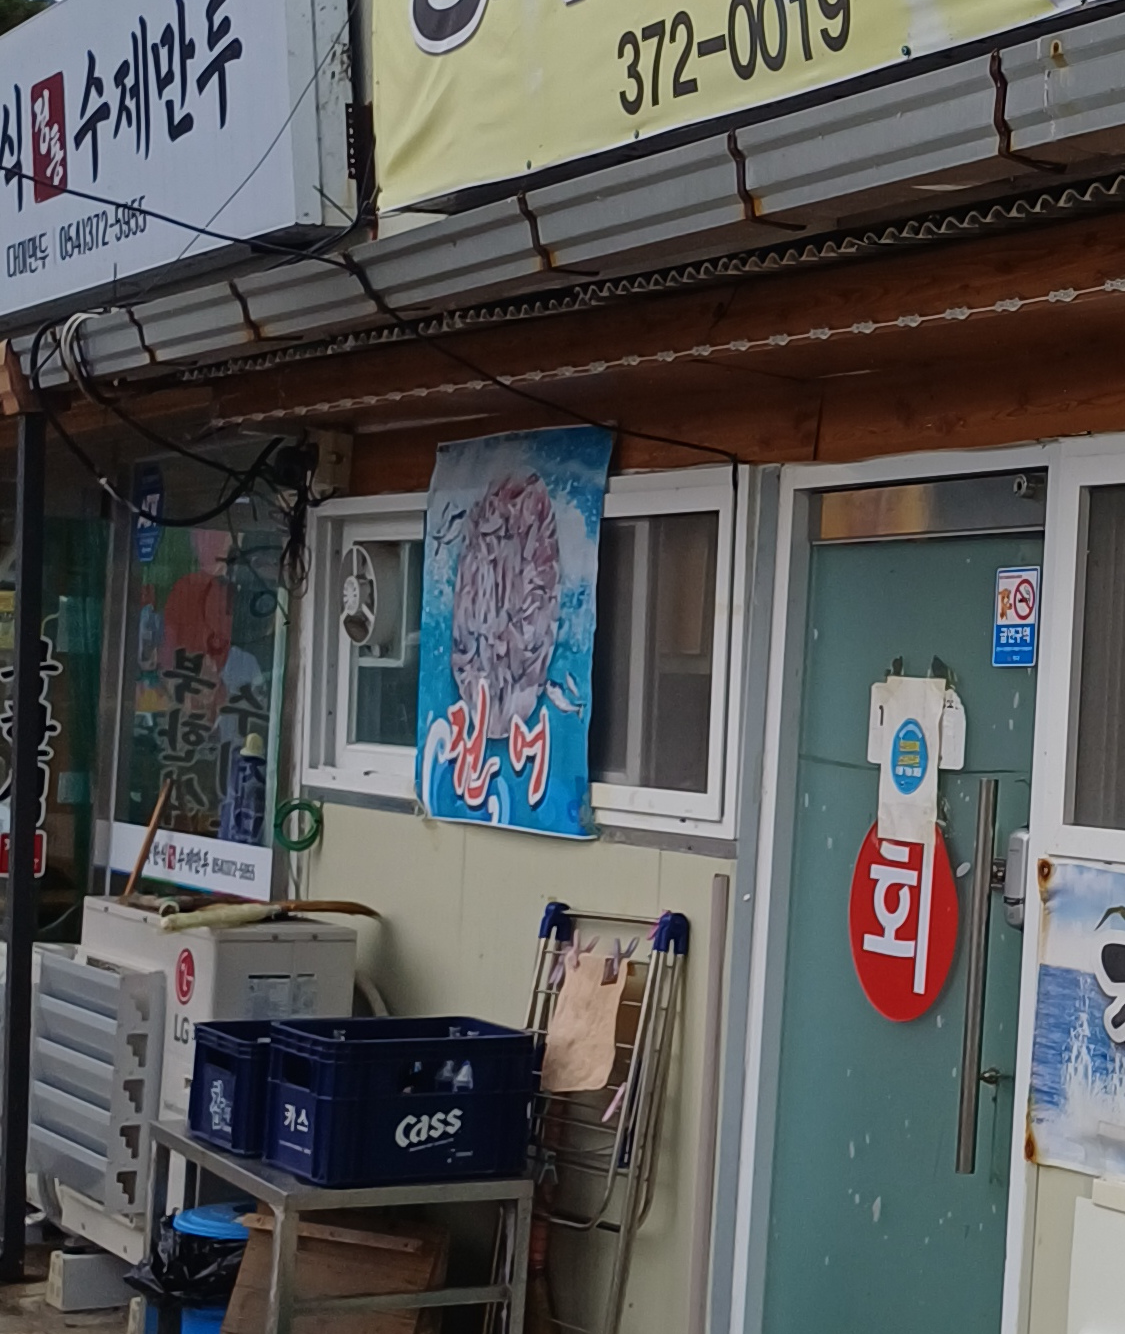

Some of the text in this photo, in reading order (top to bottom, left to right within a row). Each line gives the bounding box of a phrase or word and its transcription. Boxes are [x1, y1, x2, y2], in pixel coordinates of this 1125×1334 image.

[999, 626, 1031, 644] 금연구역
[449, 677, 551, 808] 전어
[861, 838, 938, 995] 회
[173, 1013, 190, 1045] LG
[283, 1103, 310, 1133] 카스
[394, 1107, 464, 1148] Cass
